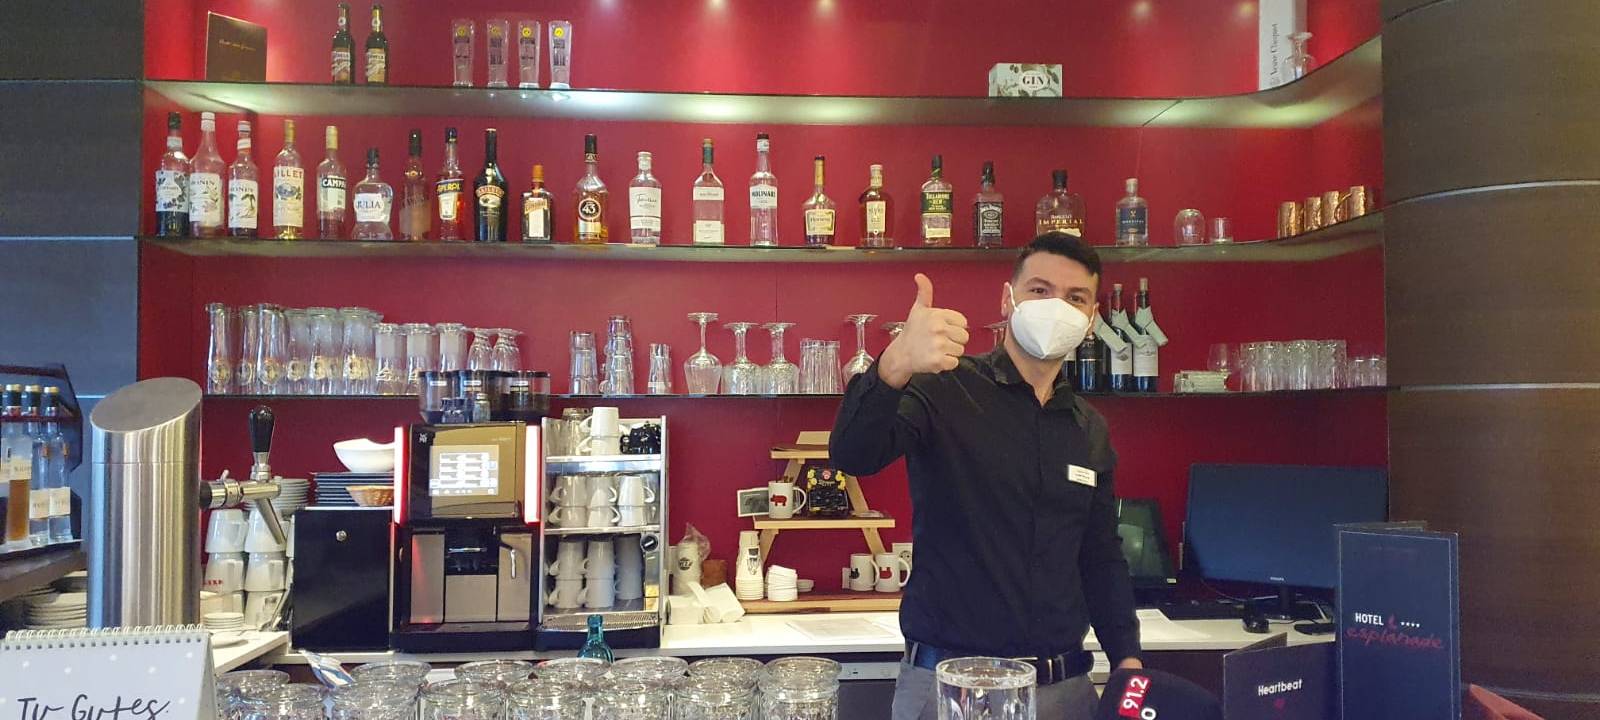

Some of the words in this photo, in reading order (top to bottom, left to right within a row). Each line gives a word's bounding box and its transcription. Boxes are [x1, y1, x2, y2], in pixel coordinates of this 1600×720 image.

[1022, 75, 1044, 85] GIN
[582, 203, 595, 214] 43
[1355, 612, 1384, 625] HOTEL
[1123, 676, 1149, 710] 91.2
[1258, 678, 1303, 696] Heartbeat
